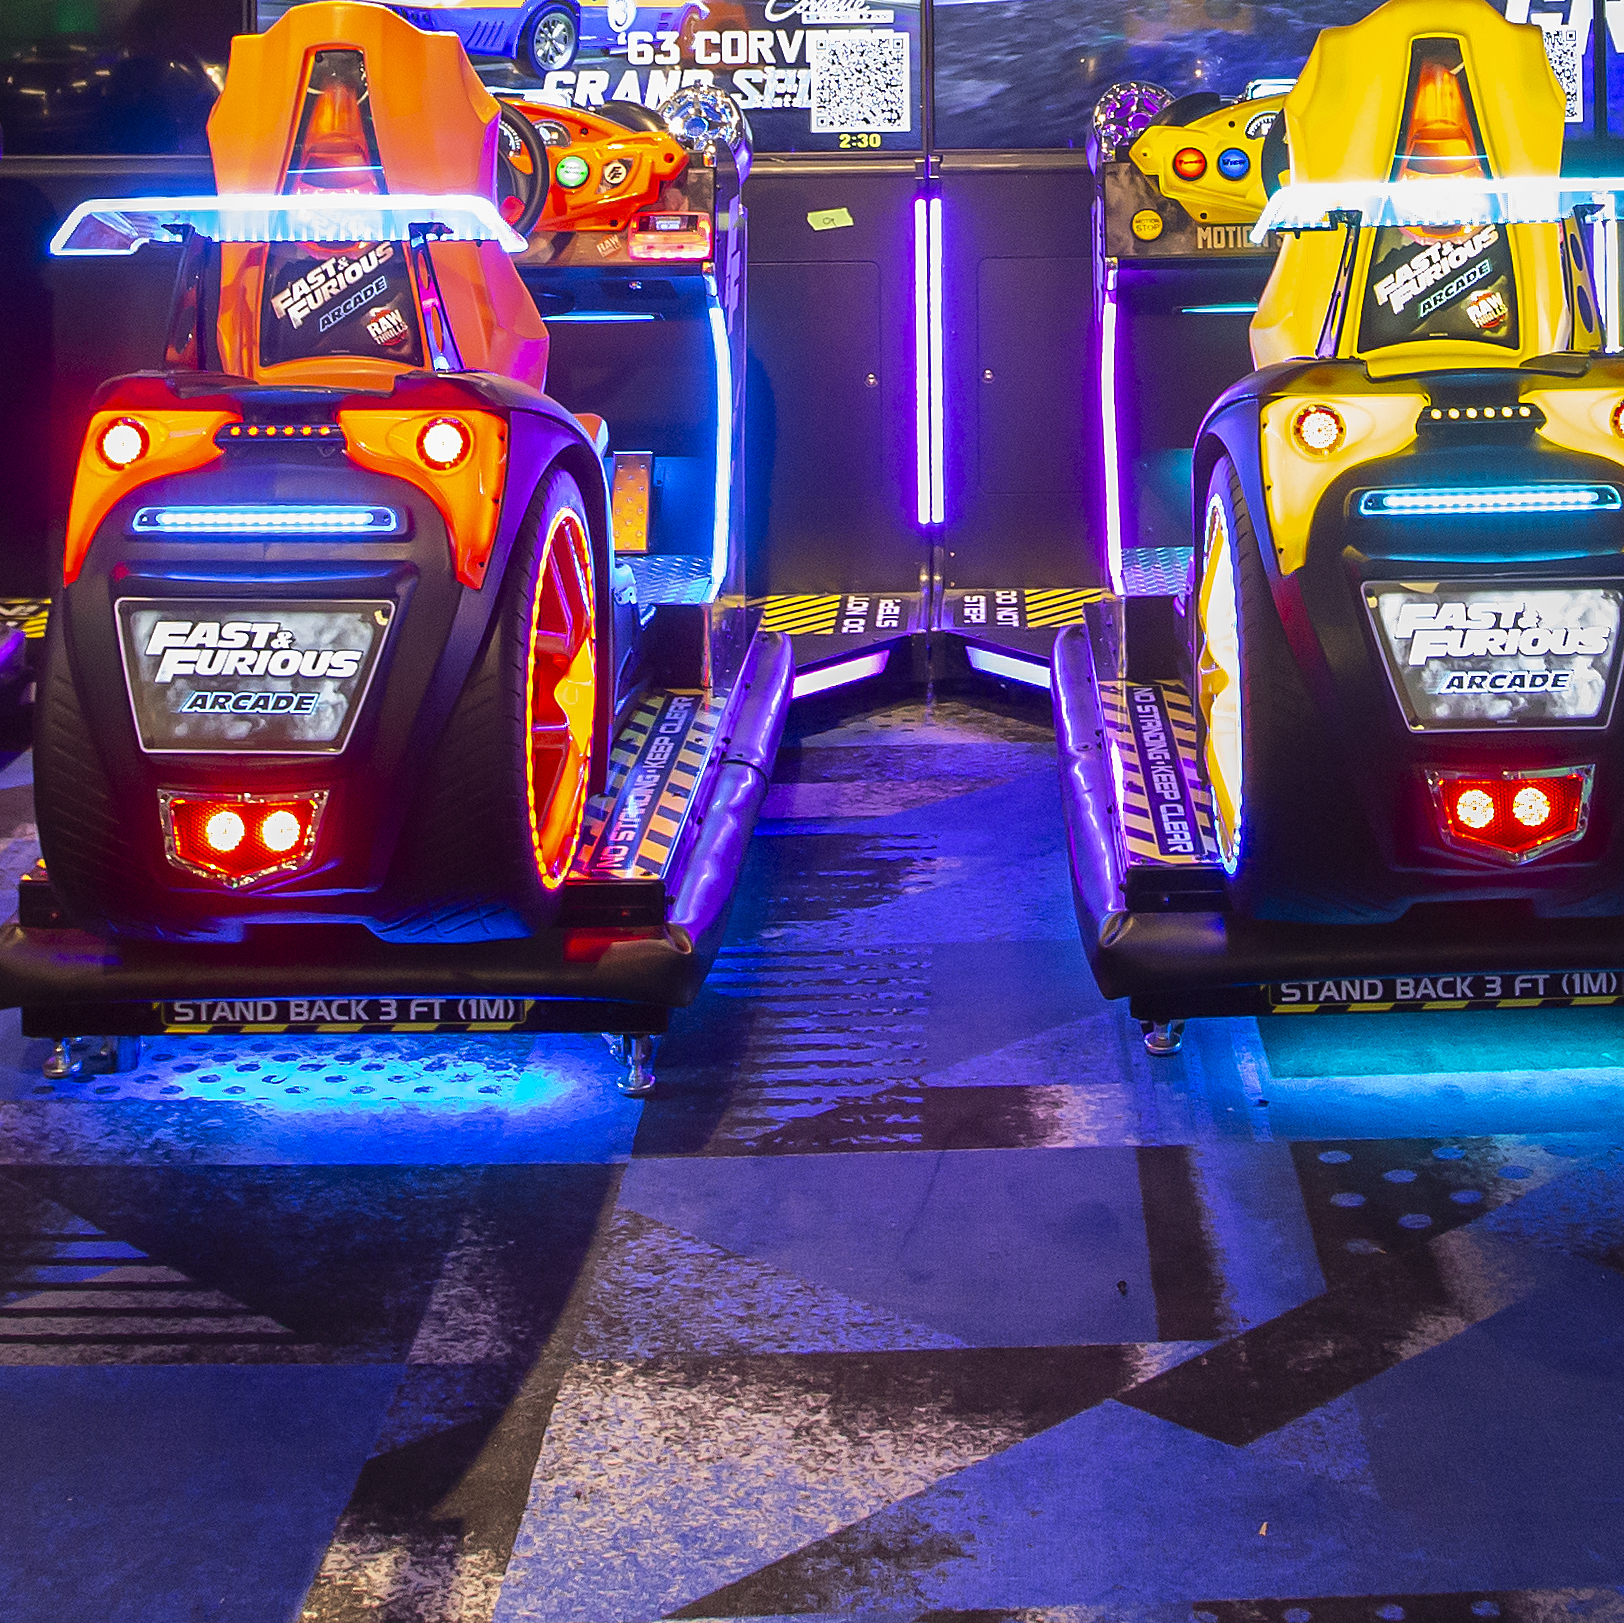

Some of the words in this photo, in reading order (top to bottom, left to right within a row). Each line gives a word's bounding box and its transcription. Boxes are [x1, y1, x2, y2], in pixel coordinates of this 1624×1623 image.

[839, 133, 882, 149] 2:30
[1136, 224, 1160, 232] STOP
[288, 242, 394, 328] FURIOUS
[1374, 241, 1442, 306] FAST
[1389, 225, 1499, 315] FURIOUS
[271, 259, 337, 318] FAST
[319, 276, 388, 332] ARCADE
[1418, 258, 1493, 319] ARCADE
[1466, 292, 1504, 320] RAW
[367, 308, 406, 339] RAW
[845, 595, 870, 616] NOT
[995, 590, 1018, 604] DO
[841, 618, 866, 633] DO
[996, 607, 1020, 627] NOT
[1394, 602, 1525, 639] FAST
[146, 621, 281, 655] FAST
[1409, 627, 1611, 666] FURIOUS
[155, 649, 363, 683] FURIOUS
[1439, 669, 1574, 694] ARCADE
[181, 691, 318, 714] ARCADE
[597, 845, 630, 868] NO
[659, 696, 694, 734] CLEAR
[1133, 687, 1156, 703] NO
[1160, 803, 1195, 853] CLEAR
[1280, 979, 1383, 1002] STAND
[1395, 976, 1475, 1000] BACK
[1484, 976, 1502, 996] 3
[1515, 975, 1550, 996] FT
[1561, 972, 1617, 995] (1M)
[174, 1000, 277, 1021] STAND
[289, 999, 370, 1021] BACK
[378, 999, 397, 1020] 3
[410, 999, 446, 1020] FT
[457, 998, 515, 1020] (1M)
